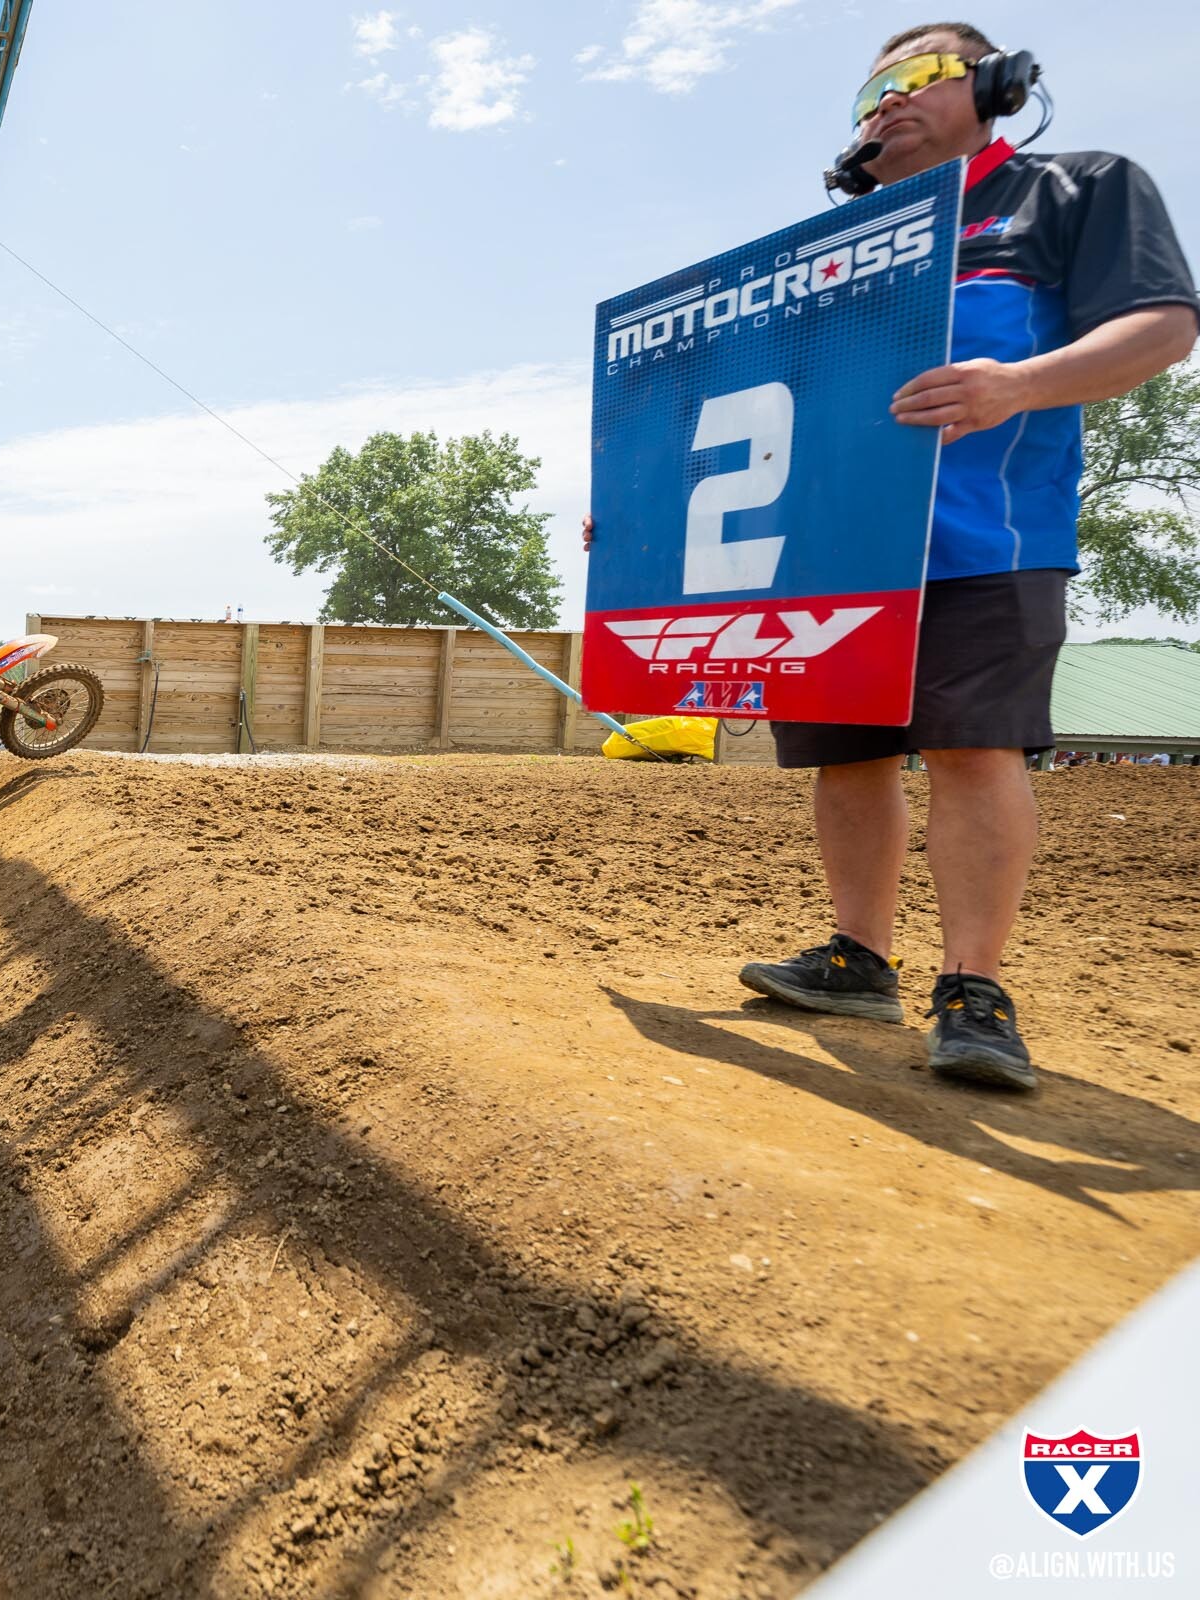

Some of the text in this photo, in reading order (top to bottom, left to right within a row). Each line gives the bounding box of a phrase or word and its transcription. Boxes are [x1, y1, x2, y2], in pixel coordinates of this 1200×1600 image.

[607, 215, 937, 362] MOTOCROSS
[708, 252, 792, 293] PRO
[607, 259, 933, 375] CHAMPIONSHIP
[683, 382, 794, 595] 2
[603, 606, 886, 660] FLY
[648, 662, 806, 674] RACING
[673, 681, 769, 710] AMA
